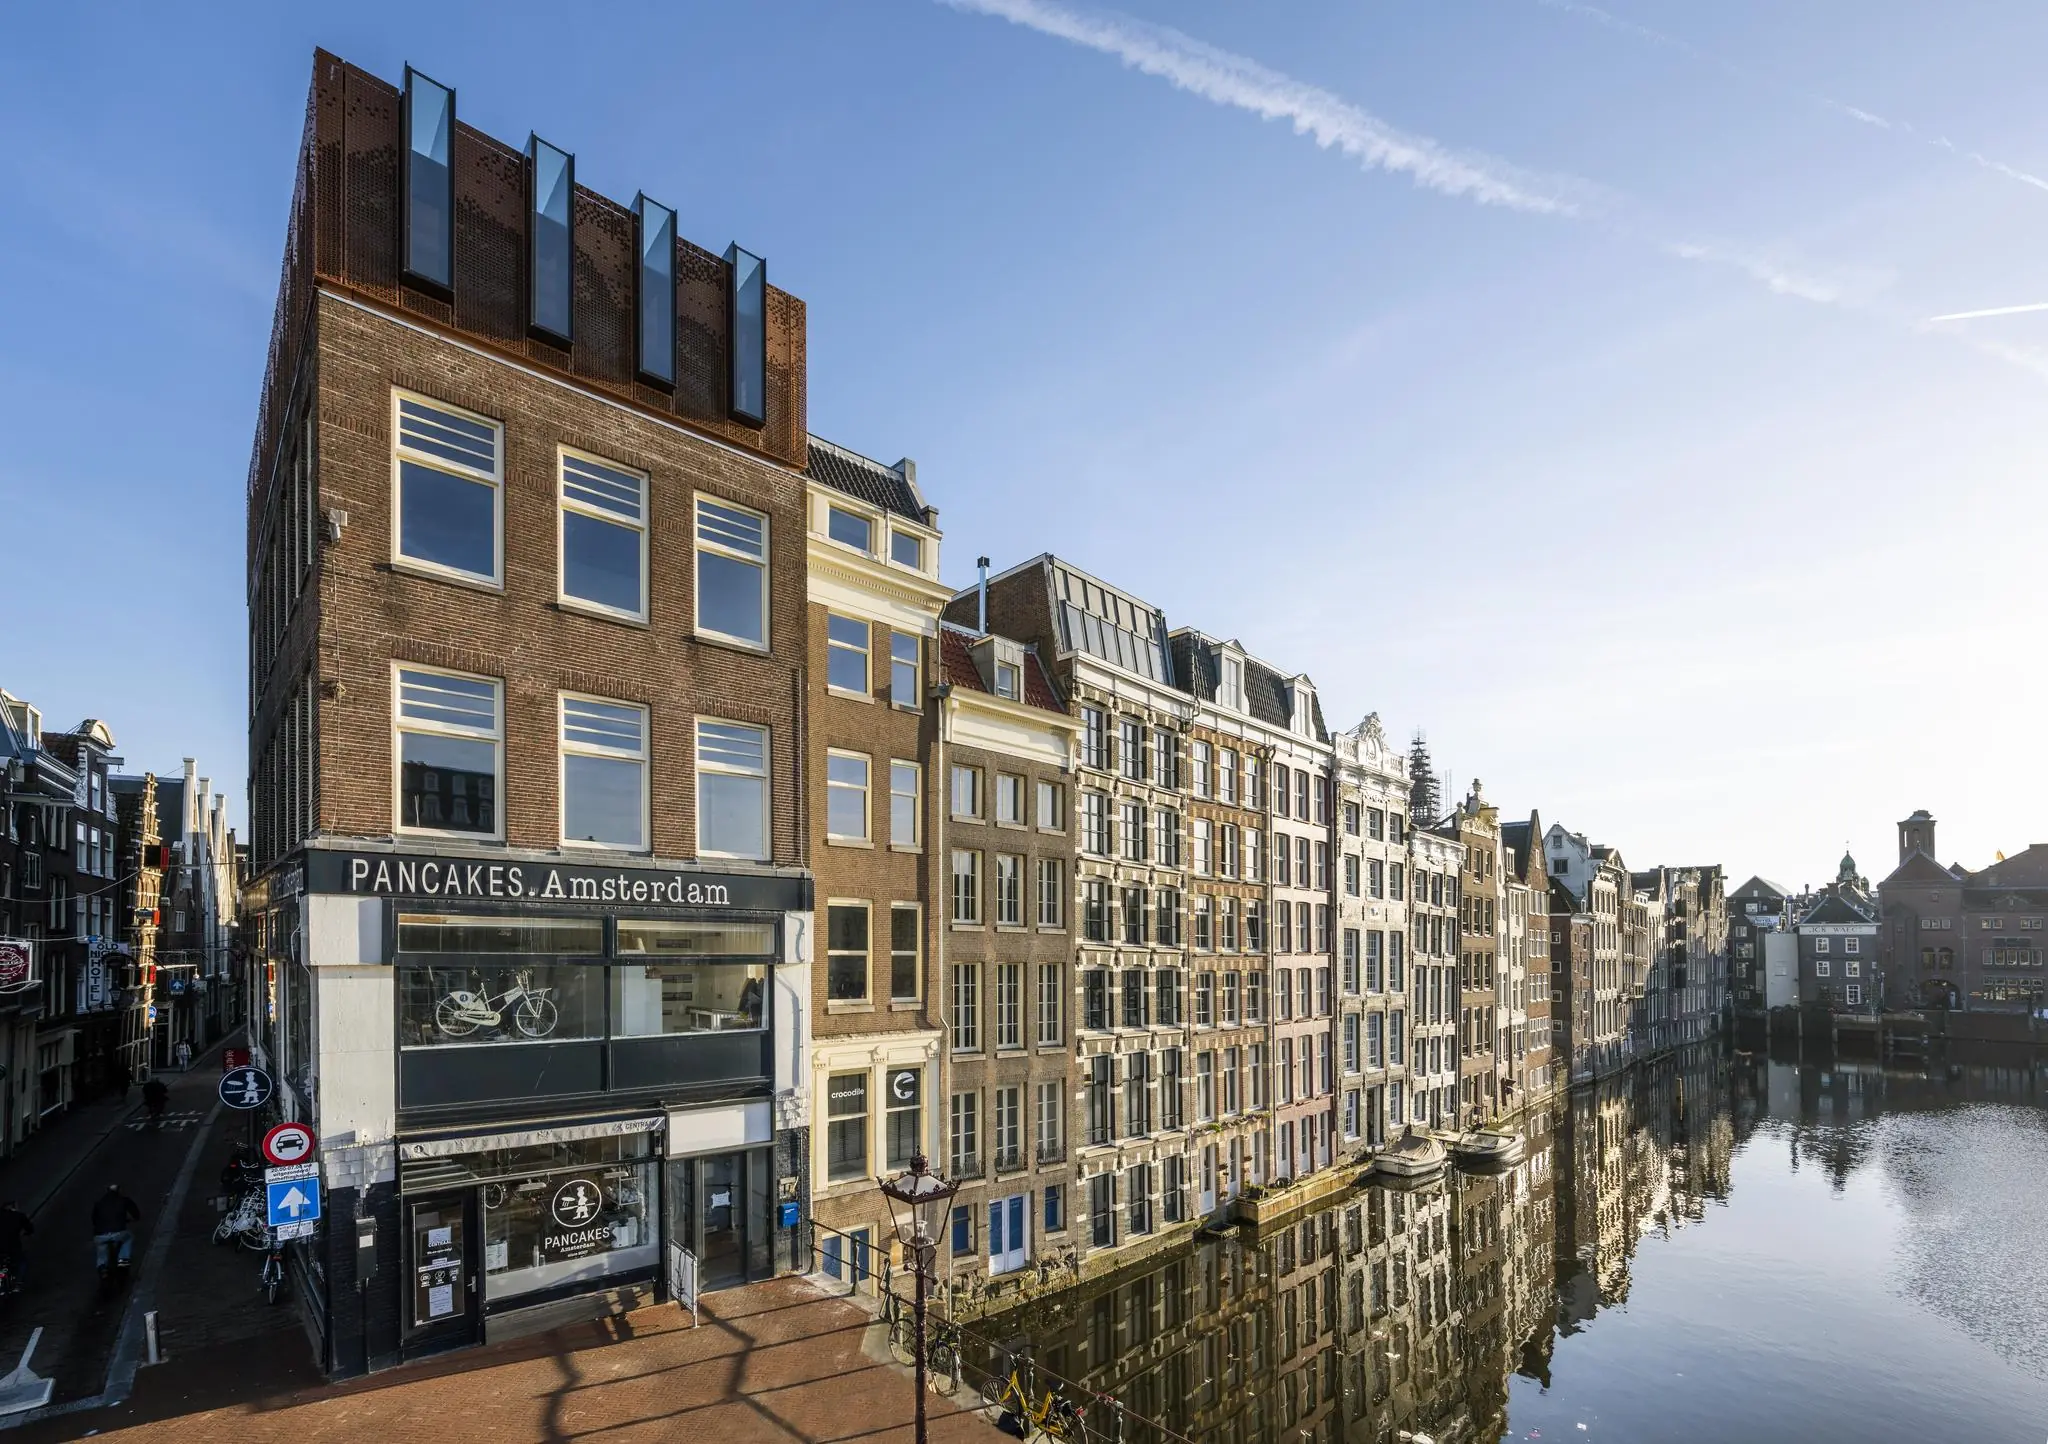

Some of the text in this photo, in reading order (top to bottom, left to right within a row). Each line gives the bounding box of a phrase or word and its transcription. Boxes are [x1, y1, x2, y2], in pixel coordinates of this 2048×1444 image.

[91, 959, 101, 1001] HOTEL
[831, 1088, 865, 1099] crocodile
[545, 1226, 610, 1250] PANCAKES
[560, 1242, 596, 1253] Amsterdam
